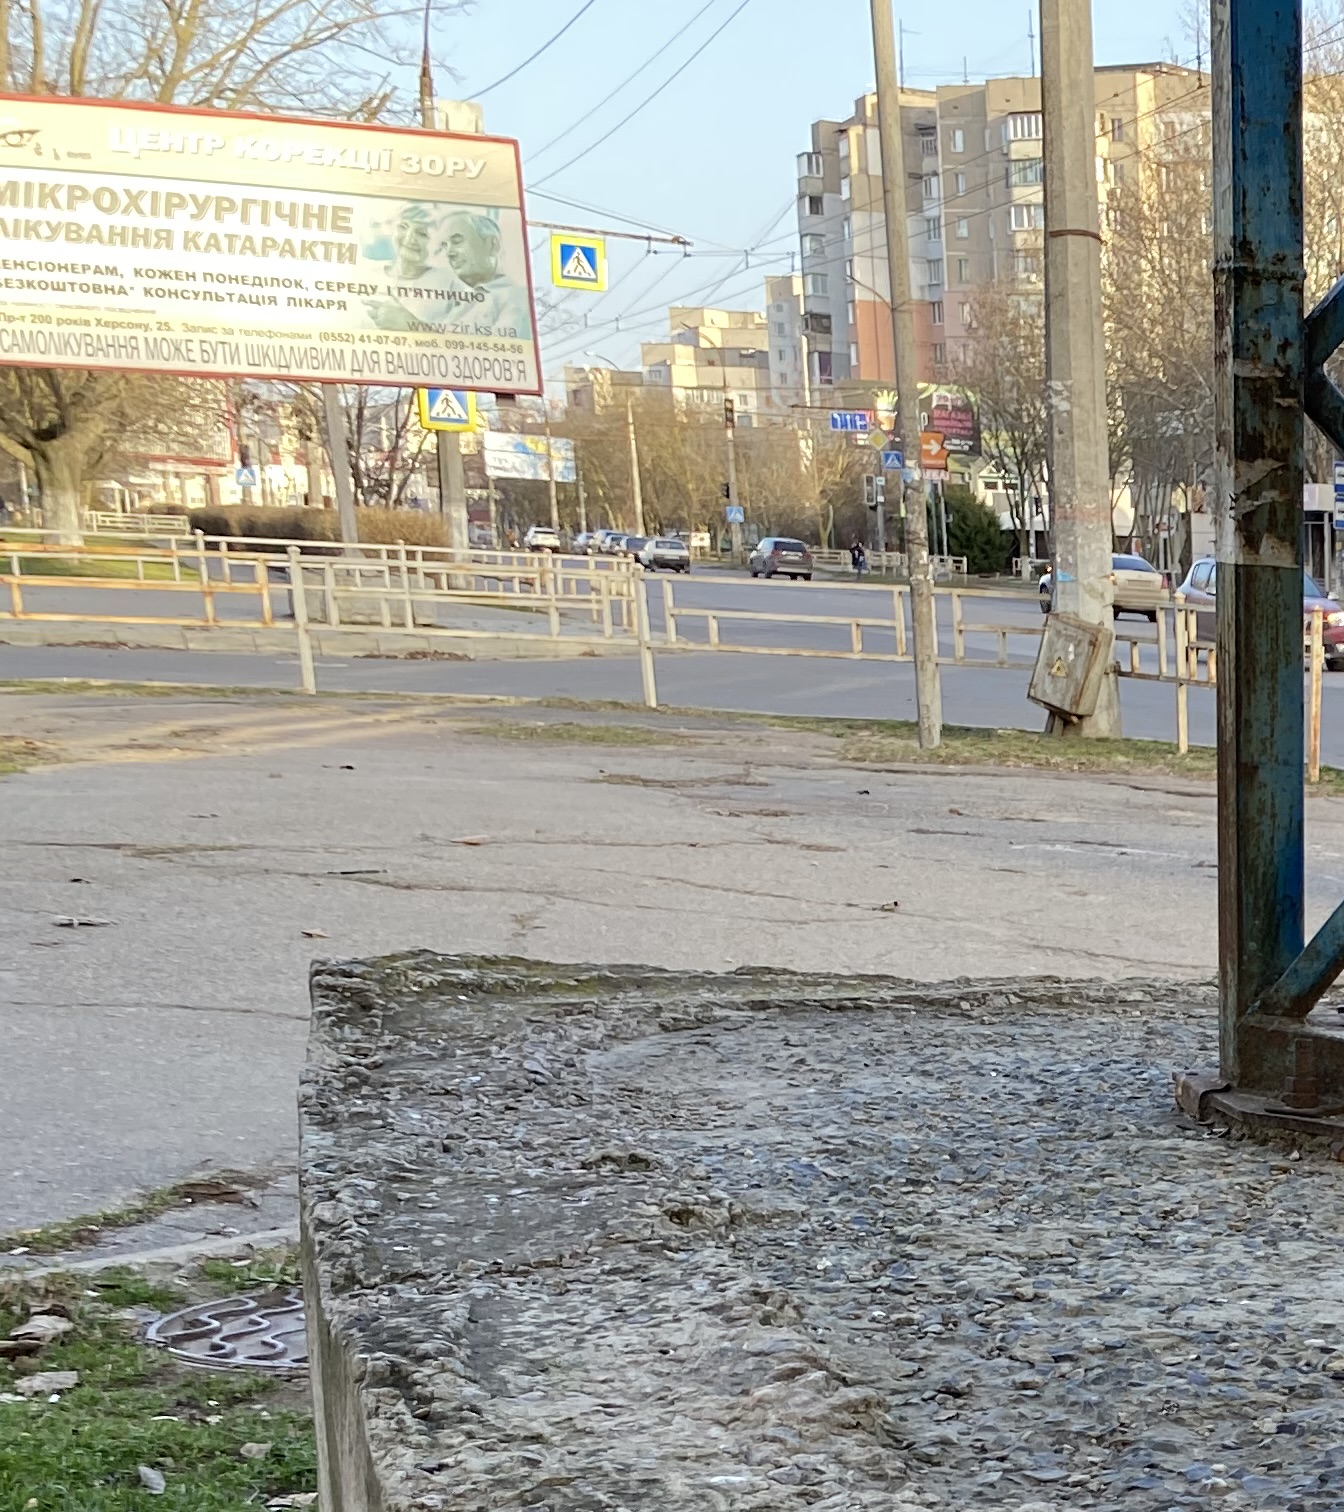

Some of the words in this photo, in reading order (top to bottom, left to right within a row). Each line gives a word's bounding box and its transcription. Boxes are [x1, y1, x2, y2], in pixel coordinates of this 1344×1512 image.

[109, 127, 226, 160] ЦЕНТР
[234, 135, 394, 174] КОРЕКЦІЇ
[401, 154, 487, 180] ЗОРУ
[183, 230, 358, 266] КАТАРАКТИ
[0, 259, 124, 279] ЕНСІОНЕРАМ,
[133, 266, 197, 282] КОЖЕН
[203, 271, 309, 292] ПОНЕДІЛОК,
[314, 280, 379, 296] СЕРЕДУ
[143, 286, 278, 306] КОНСУЛЬТАЦІЯ
[287, 297, 348, 311] ЛІКАРЯ
[30, 313, 53, 325] 200
[318, 331, 355, 345] (0552)
[0, 328, 141, 361] САМОЛІКУВАННЯ
[144, 336, 196, 363] МОЖЕ
[200, 339, 242, 366] БУТИ
[245, 342, 346, 373] ШКІДЛИВИМ
[351, 348, 381, 377] ДЛЯ
[385, 350, 449, 379] ВАШОГО
